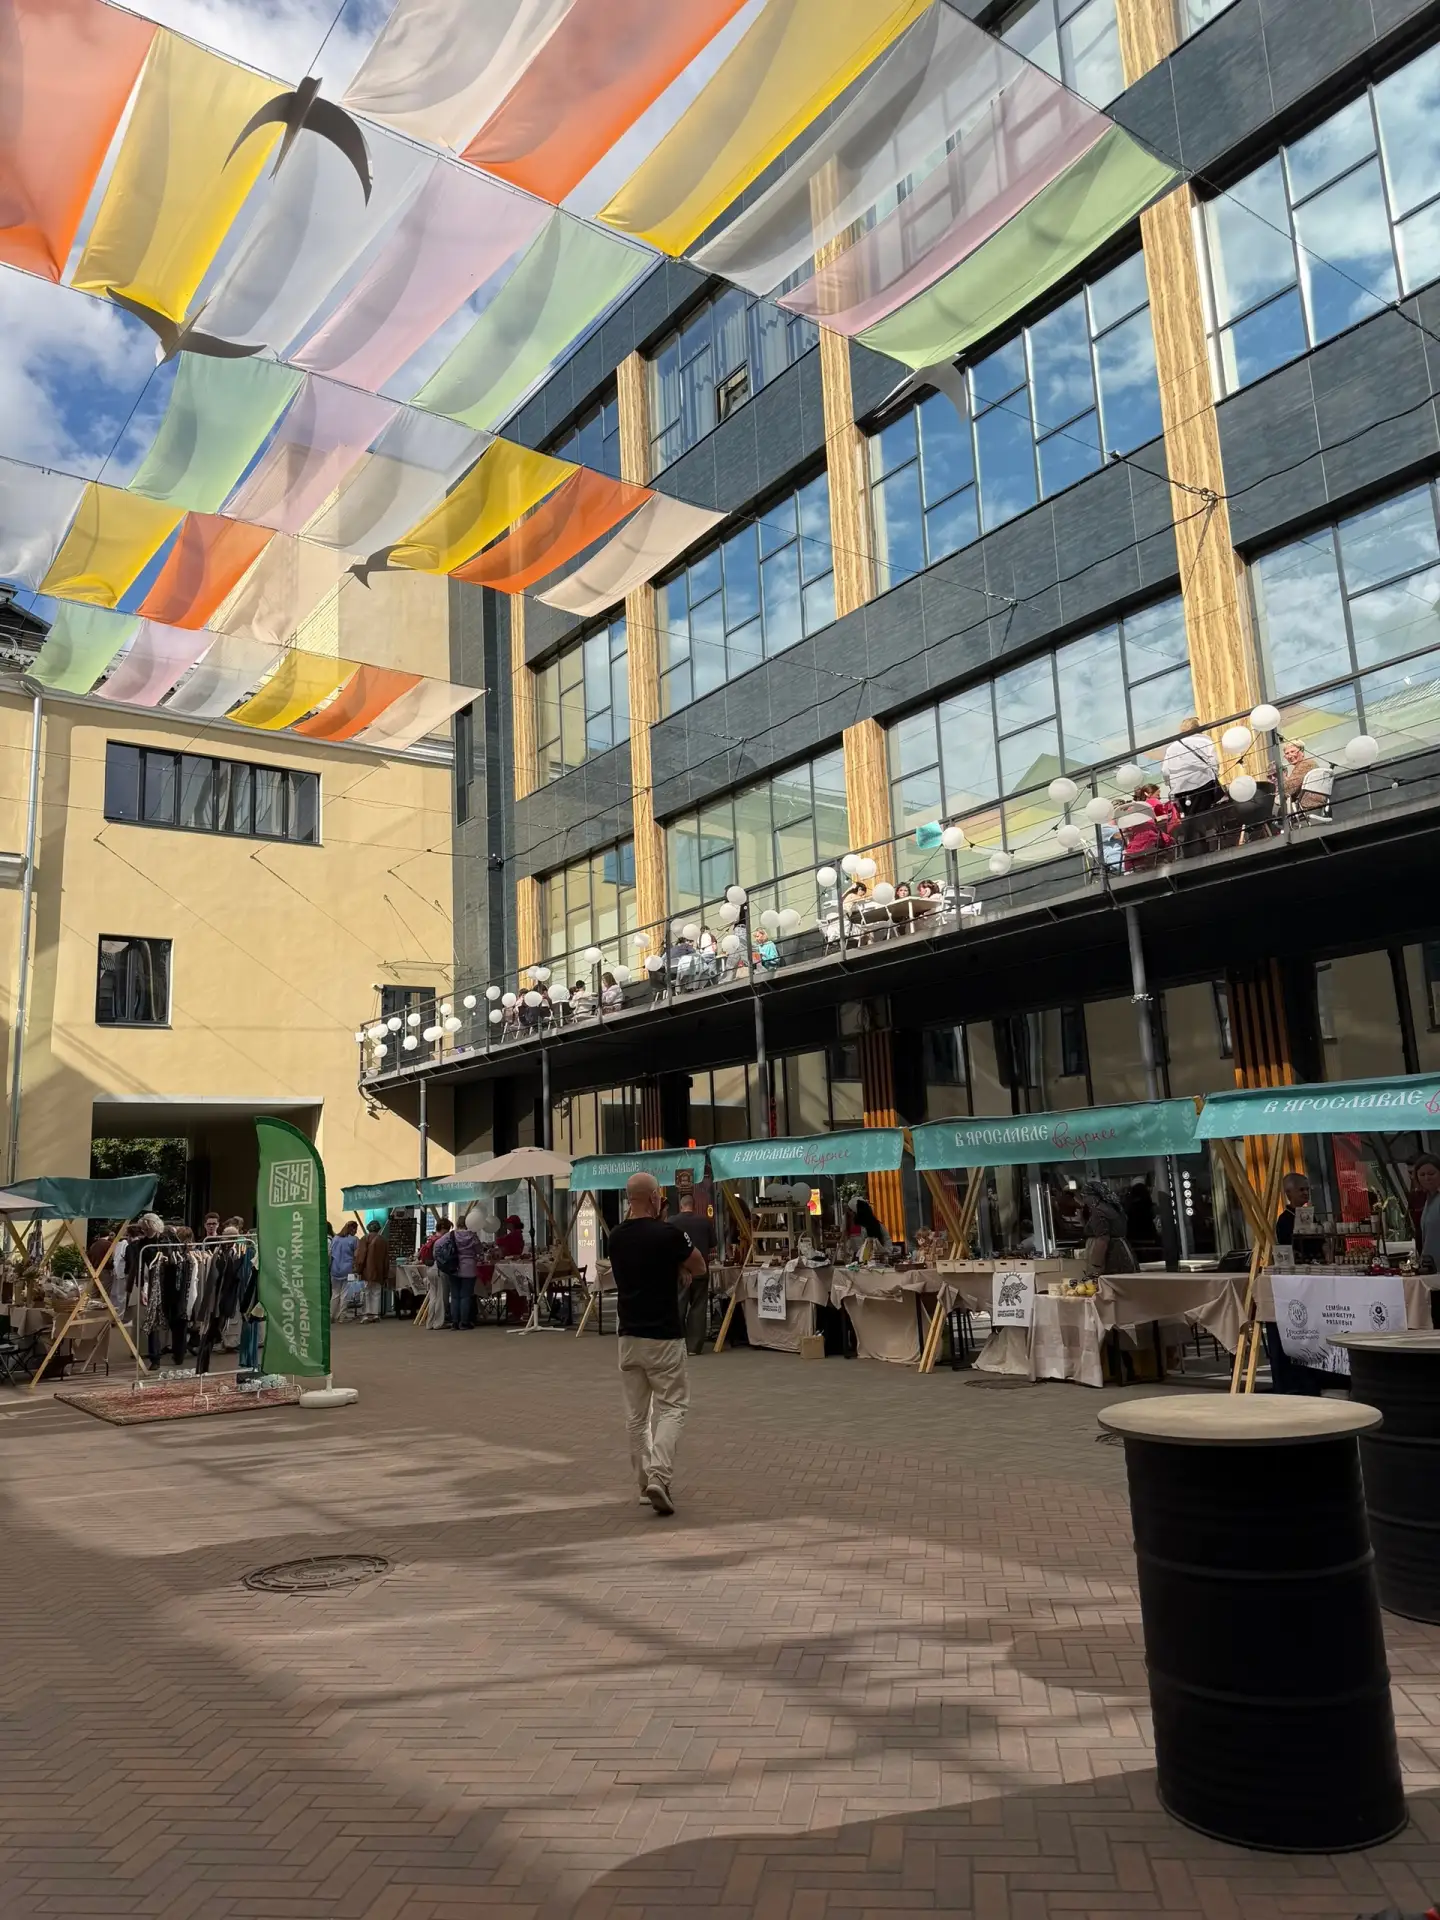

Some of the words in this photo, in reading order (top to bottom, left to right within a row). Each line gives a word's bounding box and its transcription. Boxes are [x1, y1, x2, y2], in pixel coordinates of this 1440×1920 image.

[1282, 1089, 1425, 1113] ЯРОСЛАВЛЕ
[965, 1124, 1049, 1146] ЯРОСЛАВЛЕ
[742, 1145, 804, 1163] ЯРОСЛАВЛЕ
